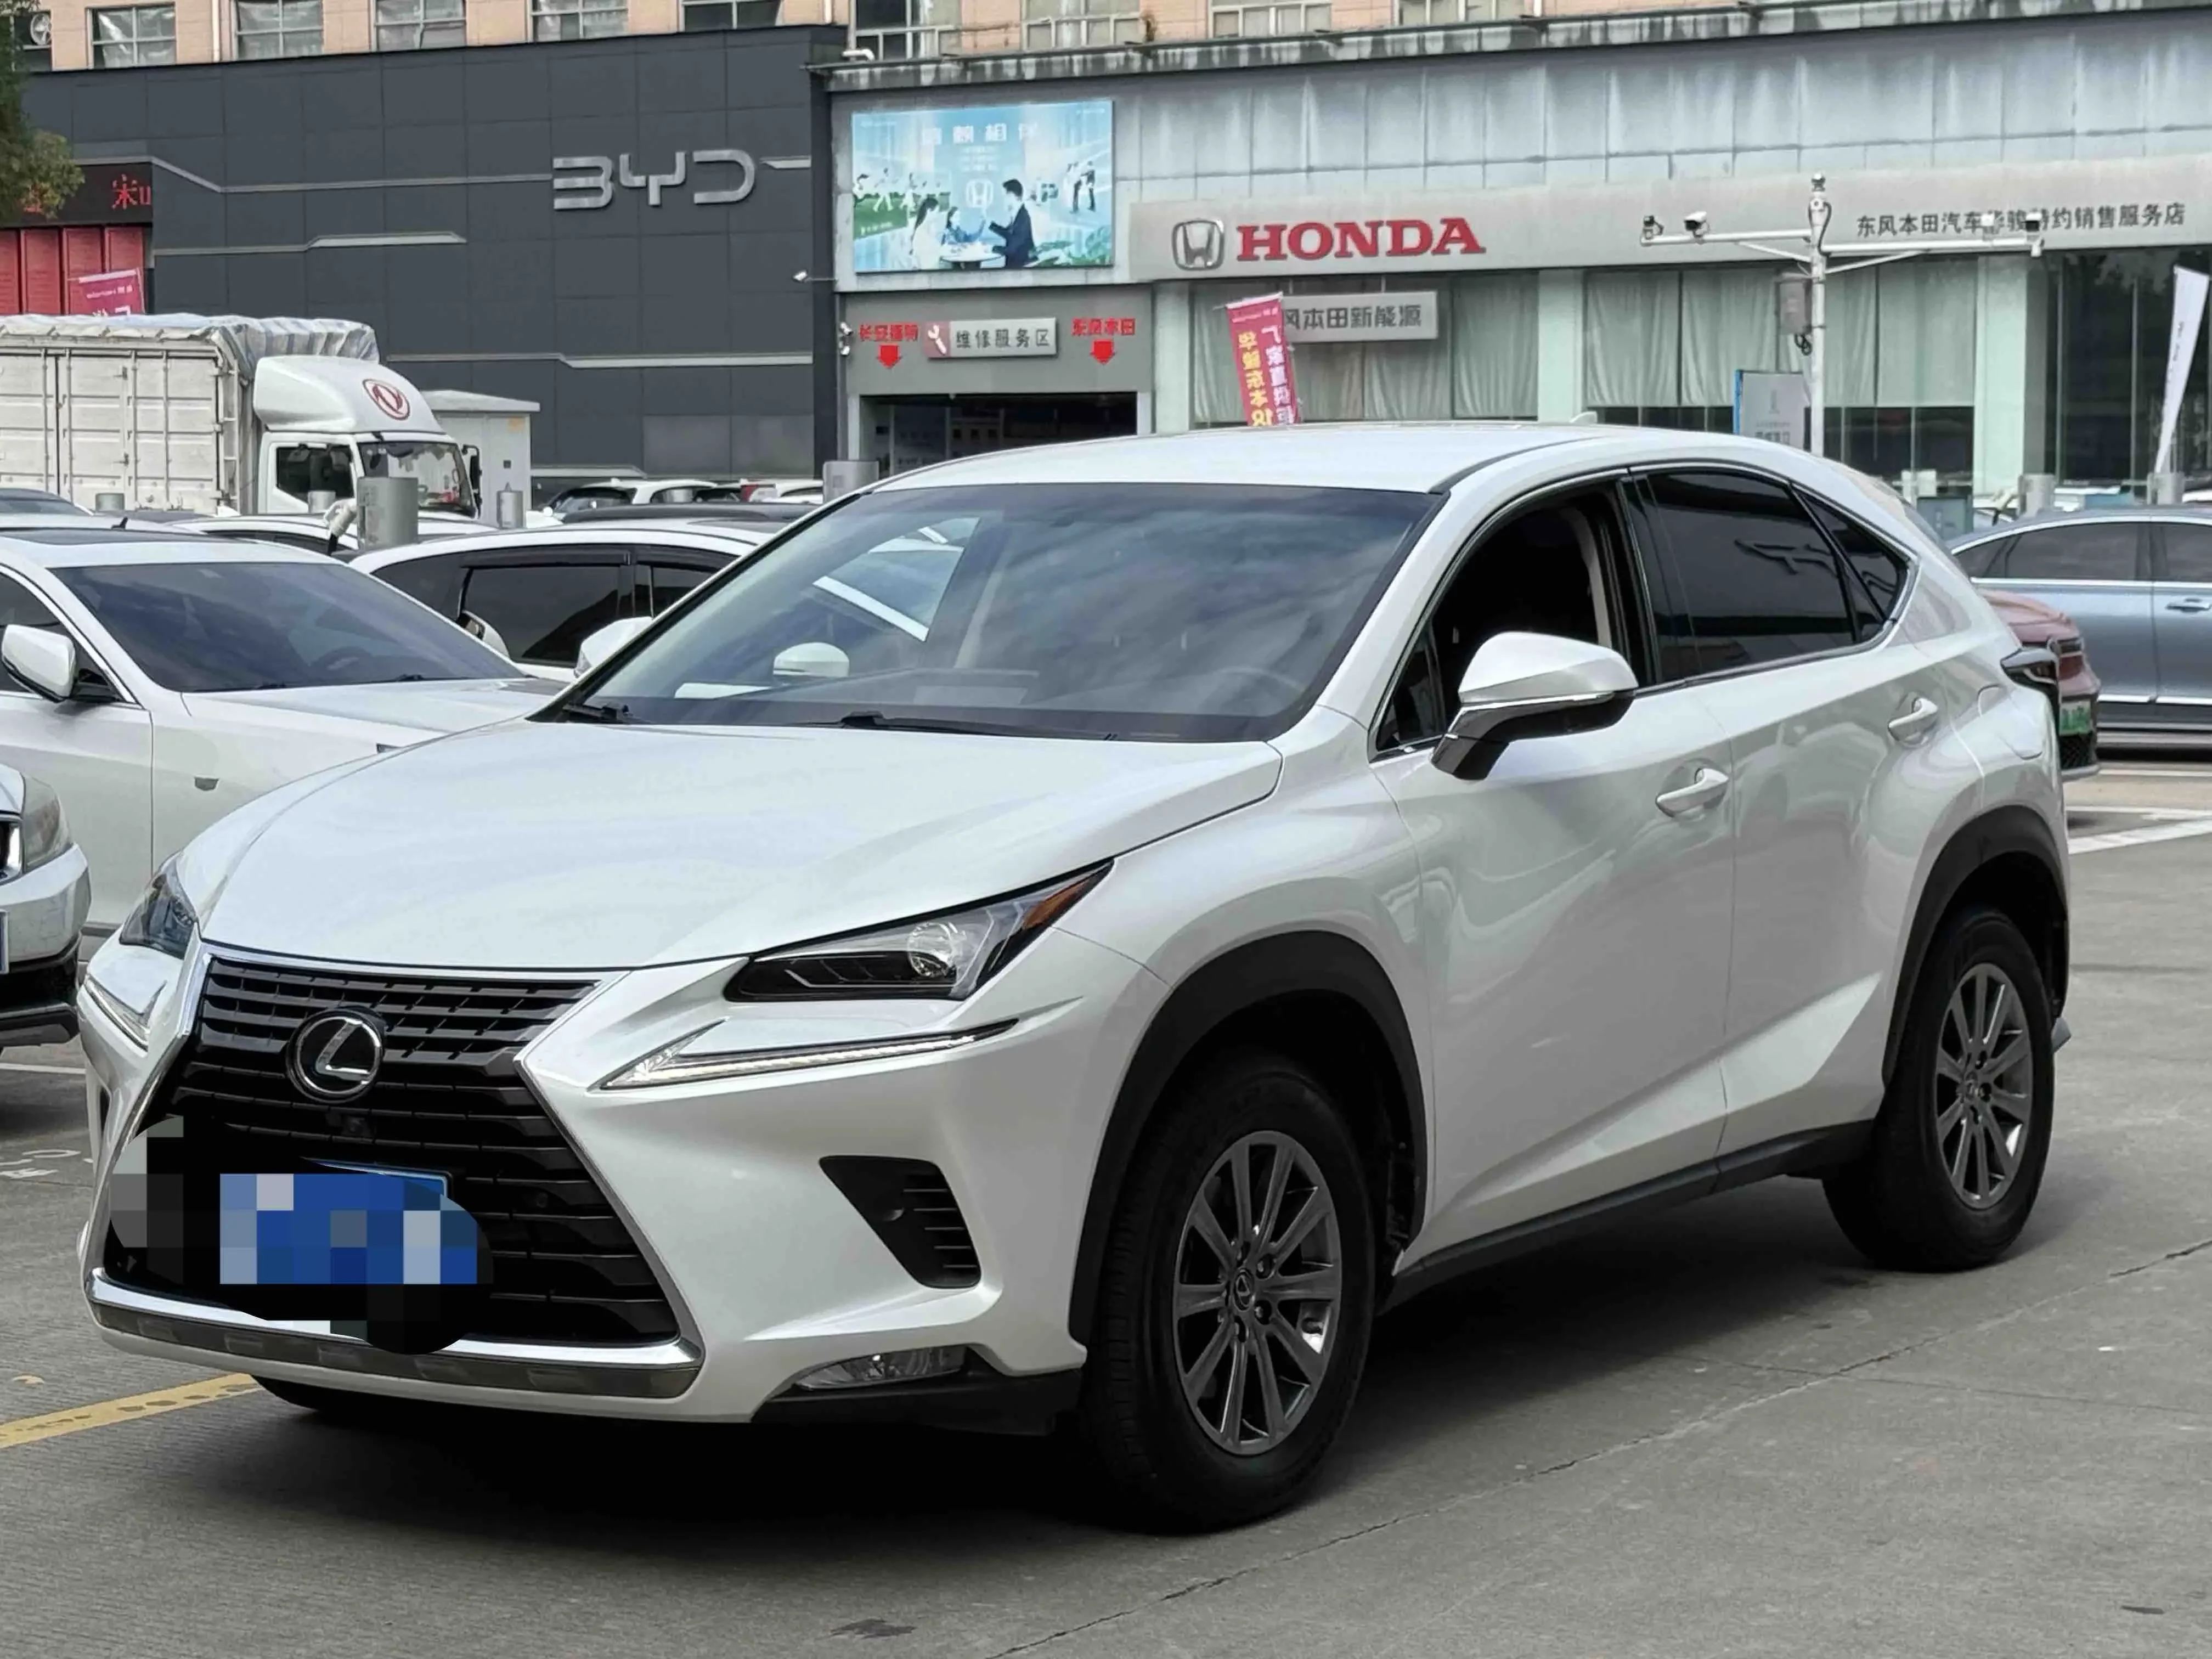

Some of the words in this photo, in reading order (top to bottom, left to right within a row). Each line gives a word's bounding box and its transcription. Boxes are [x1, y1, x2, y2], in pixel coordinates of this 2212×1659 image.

[552, 149, 755, 210] BYD
[1237, 217, 1486, 262] HONDA
[956, 328, 1050, 348] 维修服务区
